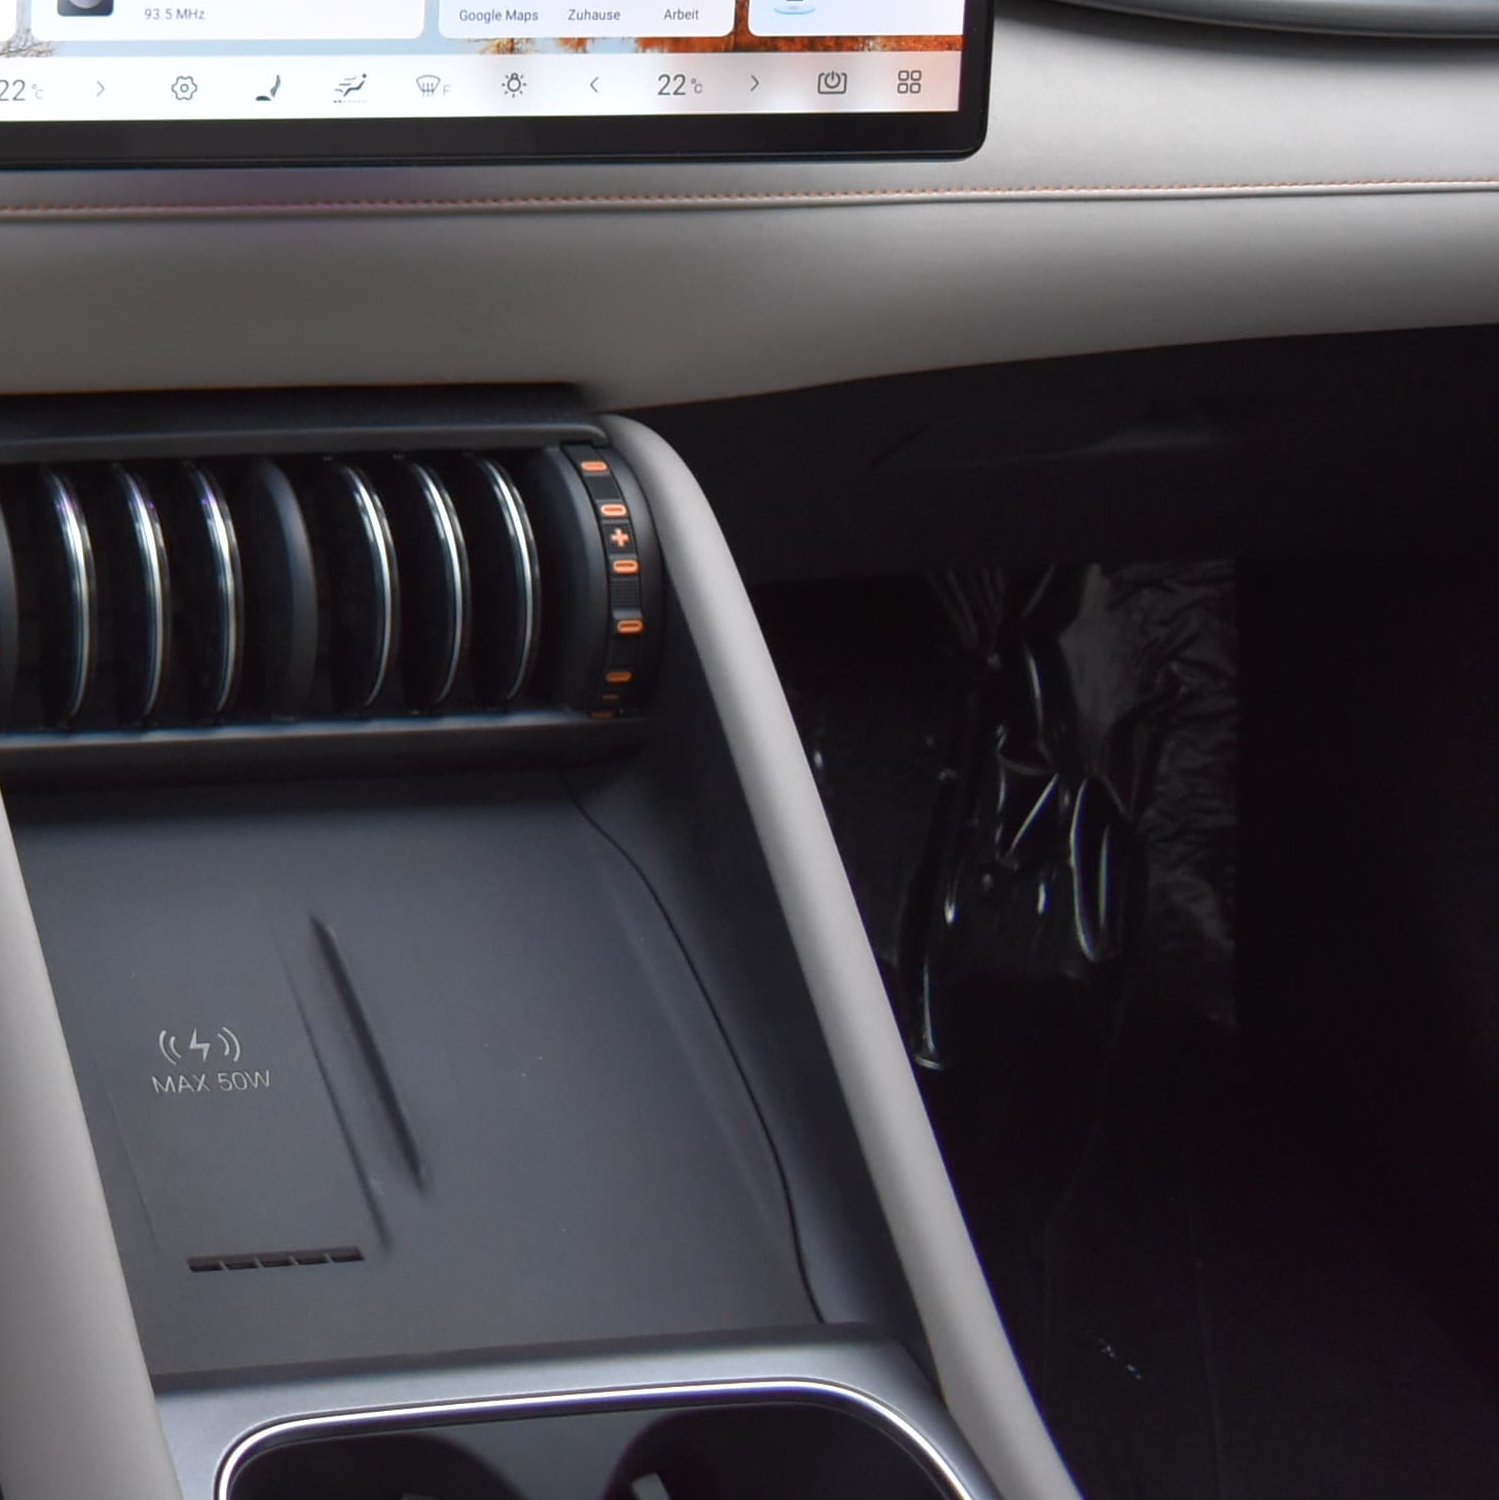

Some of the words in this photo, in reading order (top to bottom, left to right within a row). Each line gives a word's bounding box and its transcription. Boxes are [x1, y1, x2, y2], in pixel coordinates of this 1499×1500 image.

[144, 8, 172, 20] 93.5
[176, 8, 206, 20] MHz
[459, 9, 502, 23] Google
[506, 10, 539, 23] Maps
[568, 8, 621, 21] Zuhause
[664, 8, 699, 20] Arbeit
[150, 1073, 211, 1095] MAX
[216, 1069, 271, 1092] 50W
